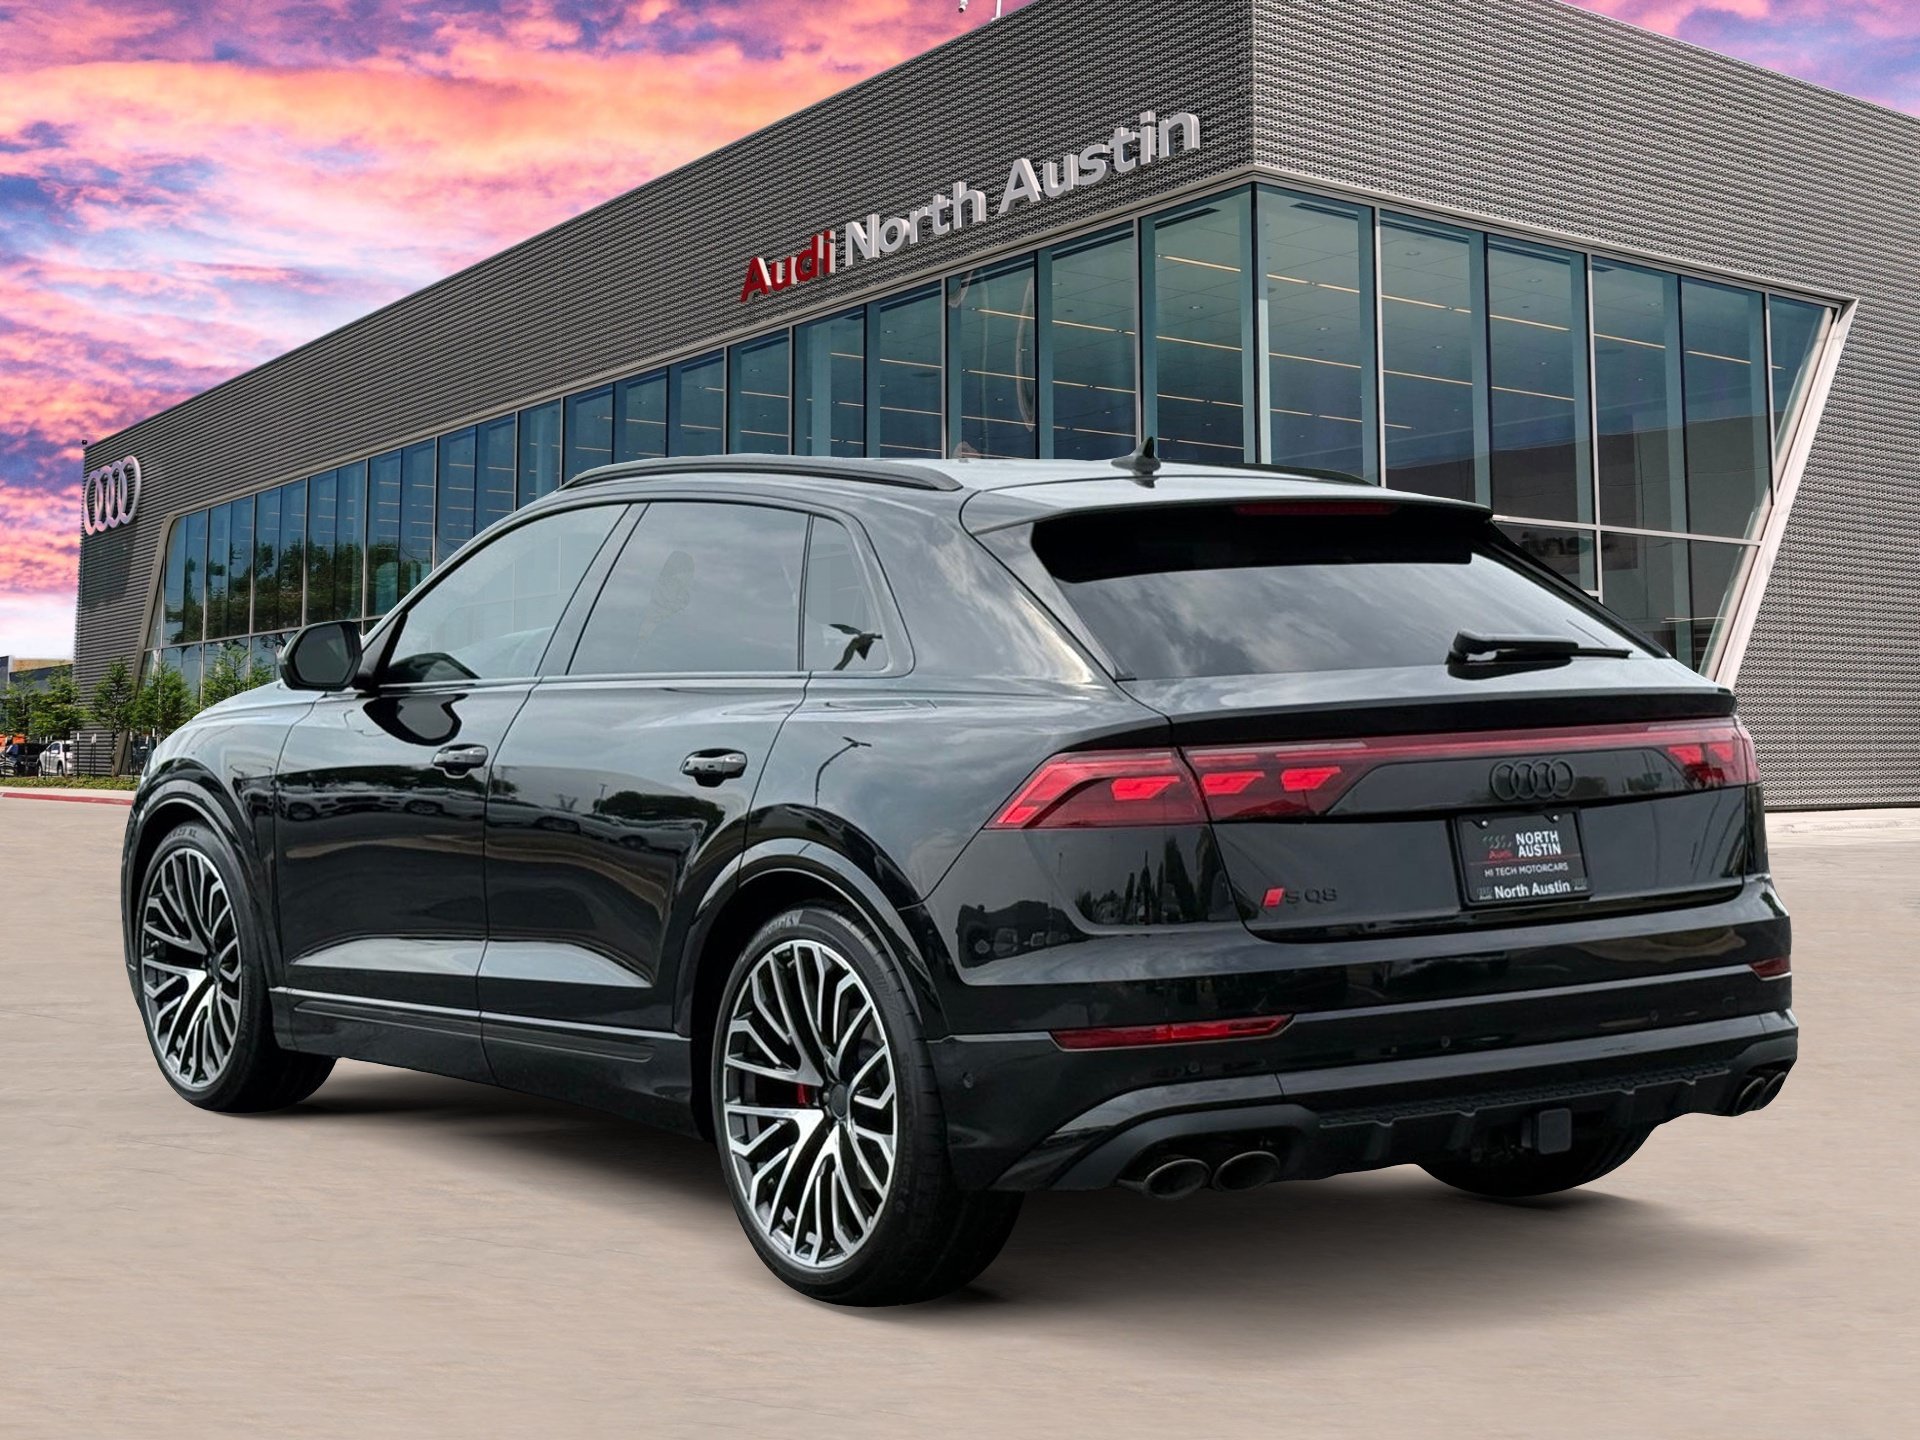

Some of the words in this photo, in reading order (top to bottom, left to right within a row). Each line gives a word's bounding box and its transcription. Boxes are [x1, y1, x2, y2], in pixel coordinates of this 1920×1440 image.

[740, 229, 837, 302] Audi
[844, 182, 987, 267] North
[998, 110, 1200, 213] Austin
[1515, 830, 1559, 846] NORTH
[1518, 843, 1562, 858] AUSTIN
[1484, 868, 1494, 877] HI
[1496, 865, 1517, 876] TECH
[1518, 862, 1569, 875] MOTORCARS
[1494, 883, 1529, 899] North
[1532, 880, 1571, 896] Austin
